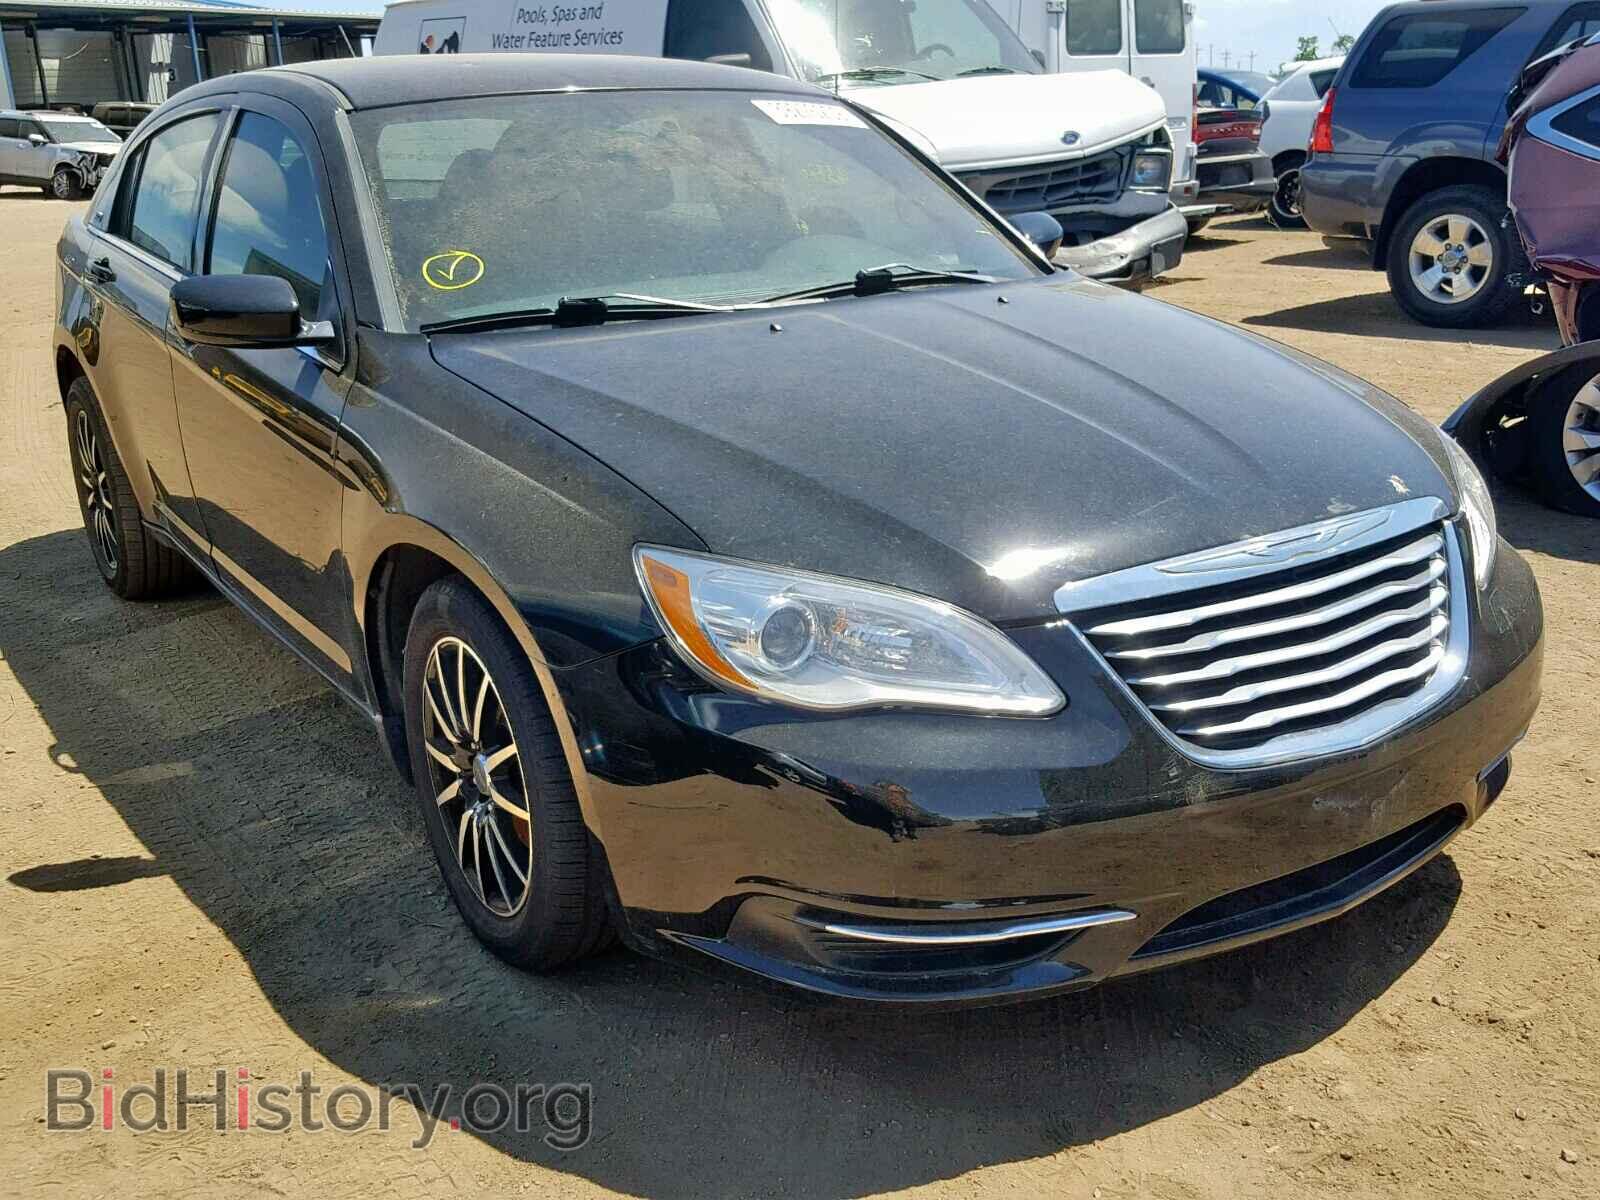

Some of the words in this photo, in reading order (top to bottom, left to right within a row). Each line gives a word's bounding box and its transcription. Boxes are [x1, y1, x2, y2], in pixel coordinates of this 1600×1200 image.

[516, 7, 548, 25] Pools,
[551, 5, 577, 26] Spas
[579, 2, 603, 20] and
[492, 33, 526, 49] Water
[527, 31, 570, 48] Feature
[573, 27, 624, 46] Services
